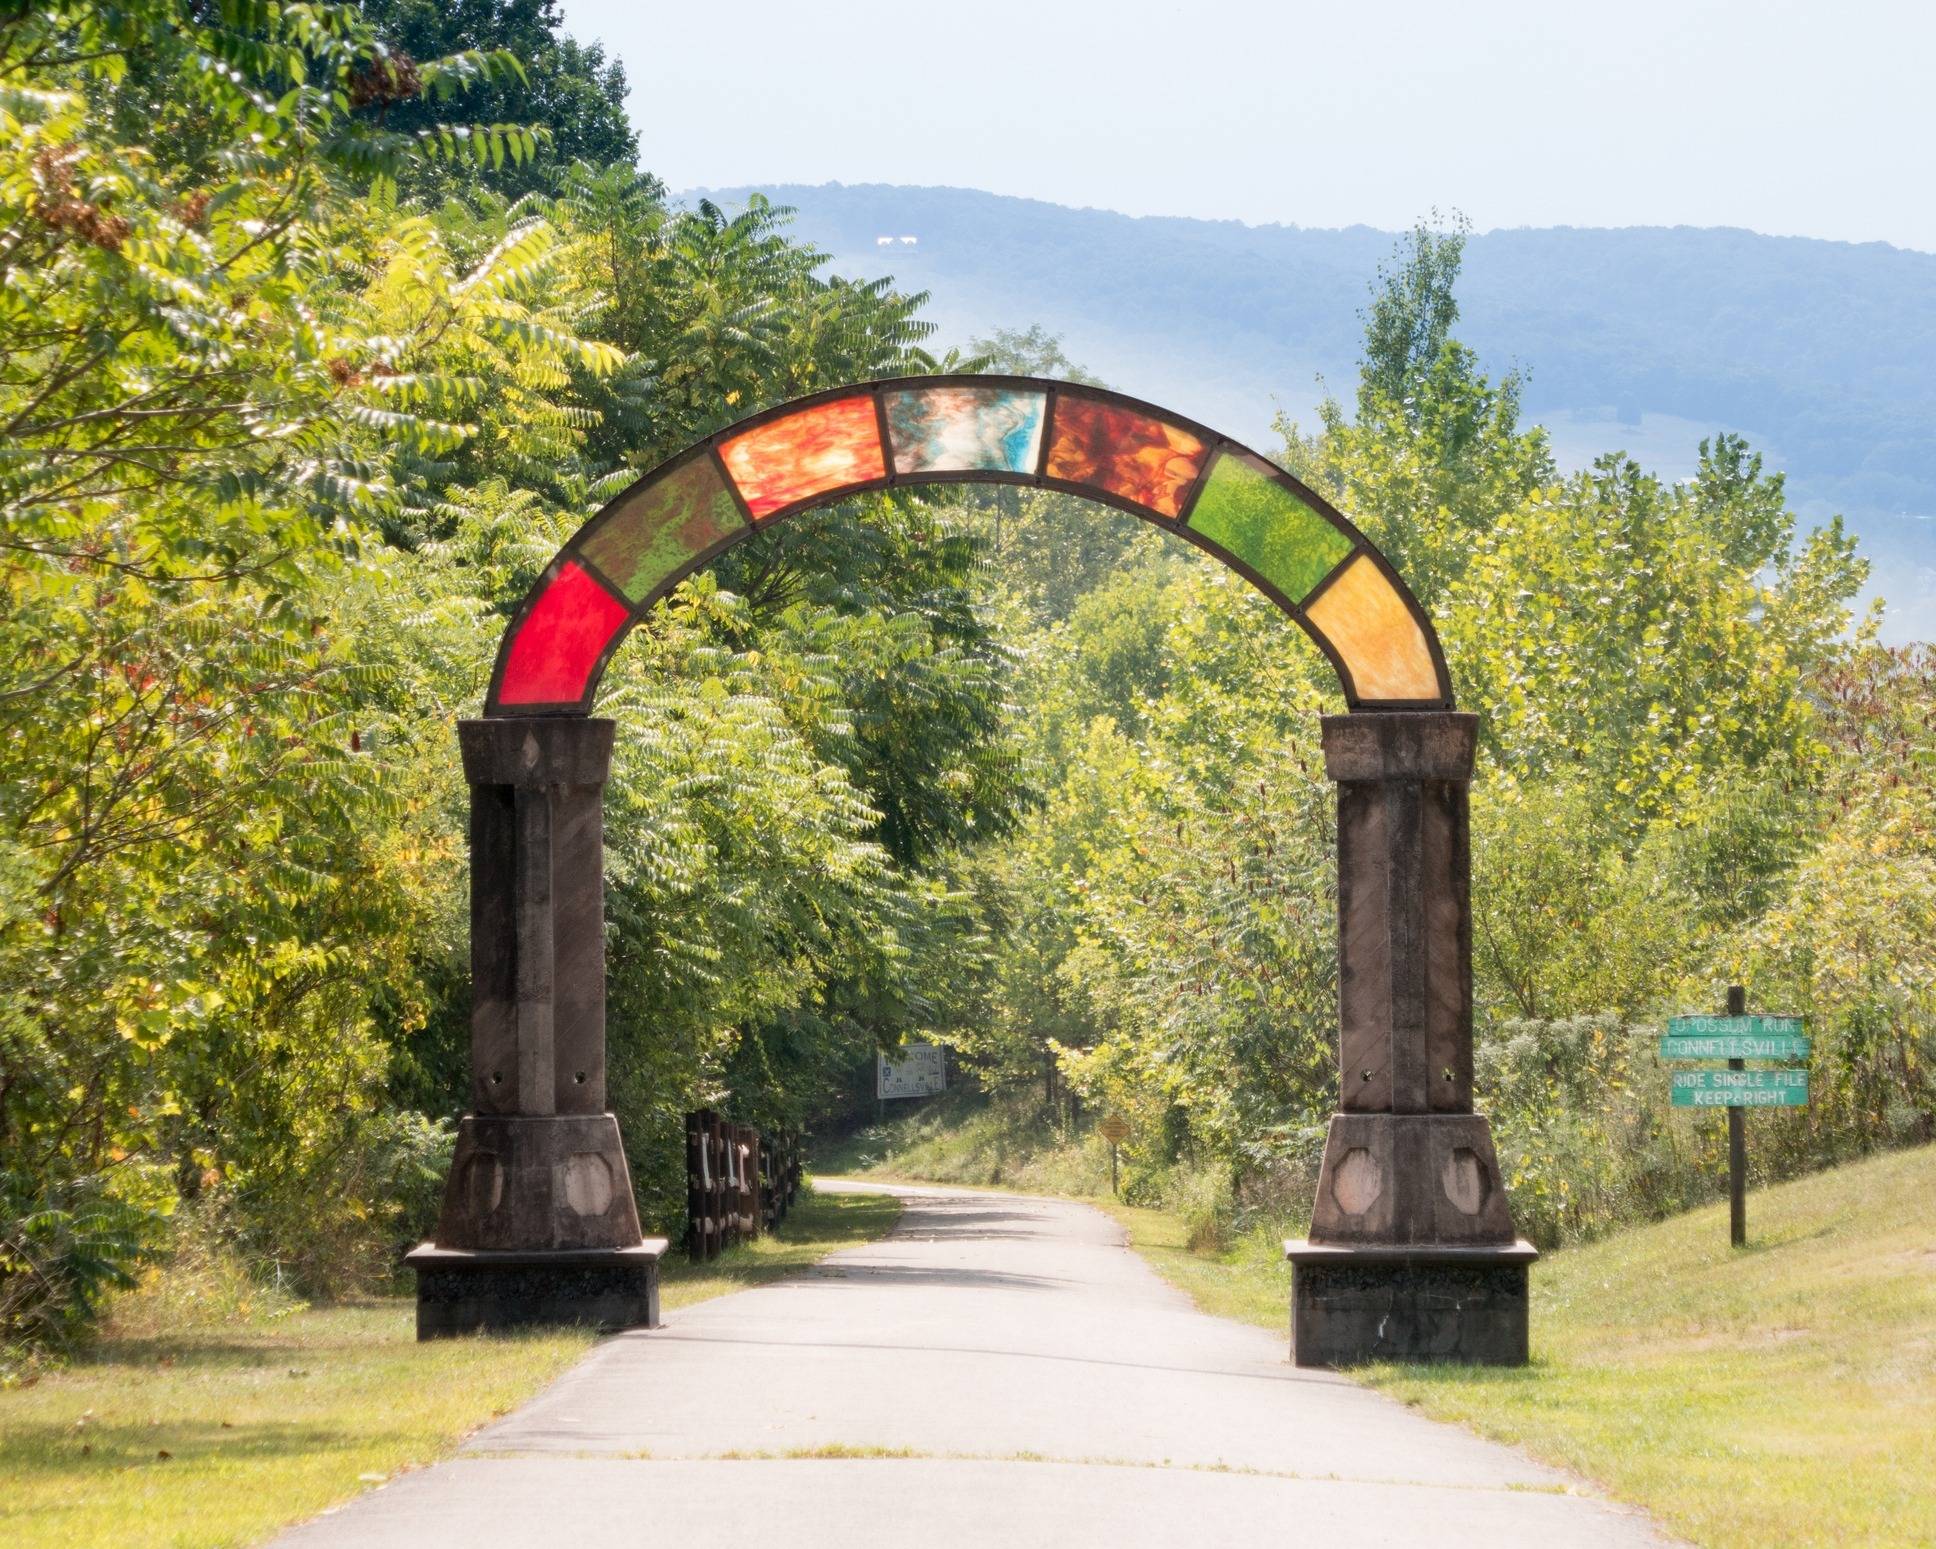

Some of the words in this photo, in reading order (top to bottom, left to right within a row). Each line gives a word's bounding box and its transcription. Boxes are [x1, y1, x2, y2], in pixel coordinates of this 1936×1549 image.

[1763, 1017, 1795, 1033] RUN
[1674, 1073, 1706, 1088] RIDE
[1713, 1073, 1764, 1088] SINGLE
[1775, 1073, 1807, 1087] FILE
[1694, 1090, 1732, 1105] KEEP
[1743, 1090, 1787, 1105] RIGHT
